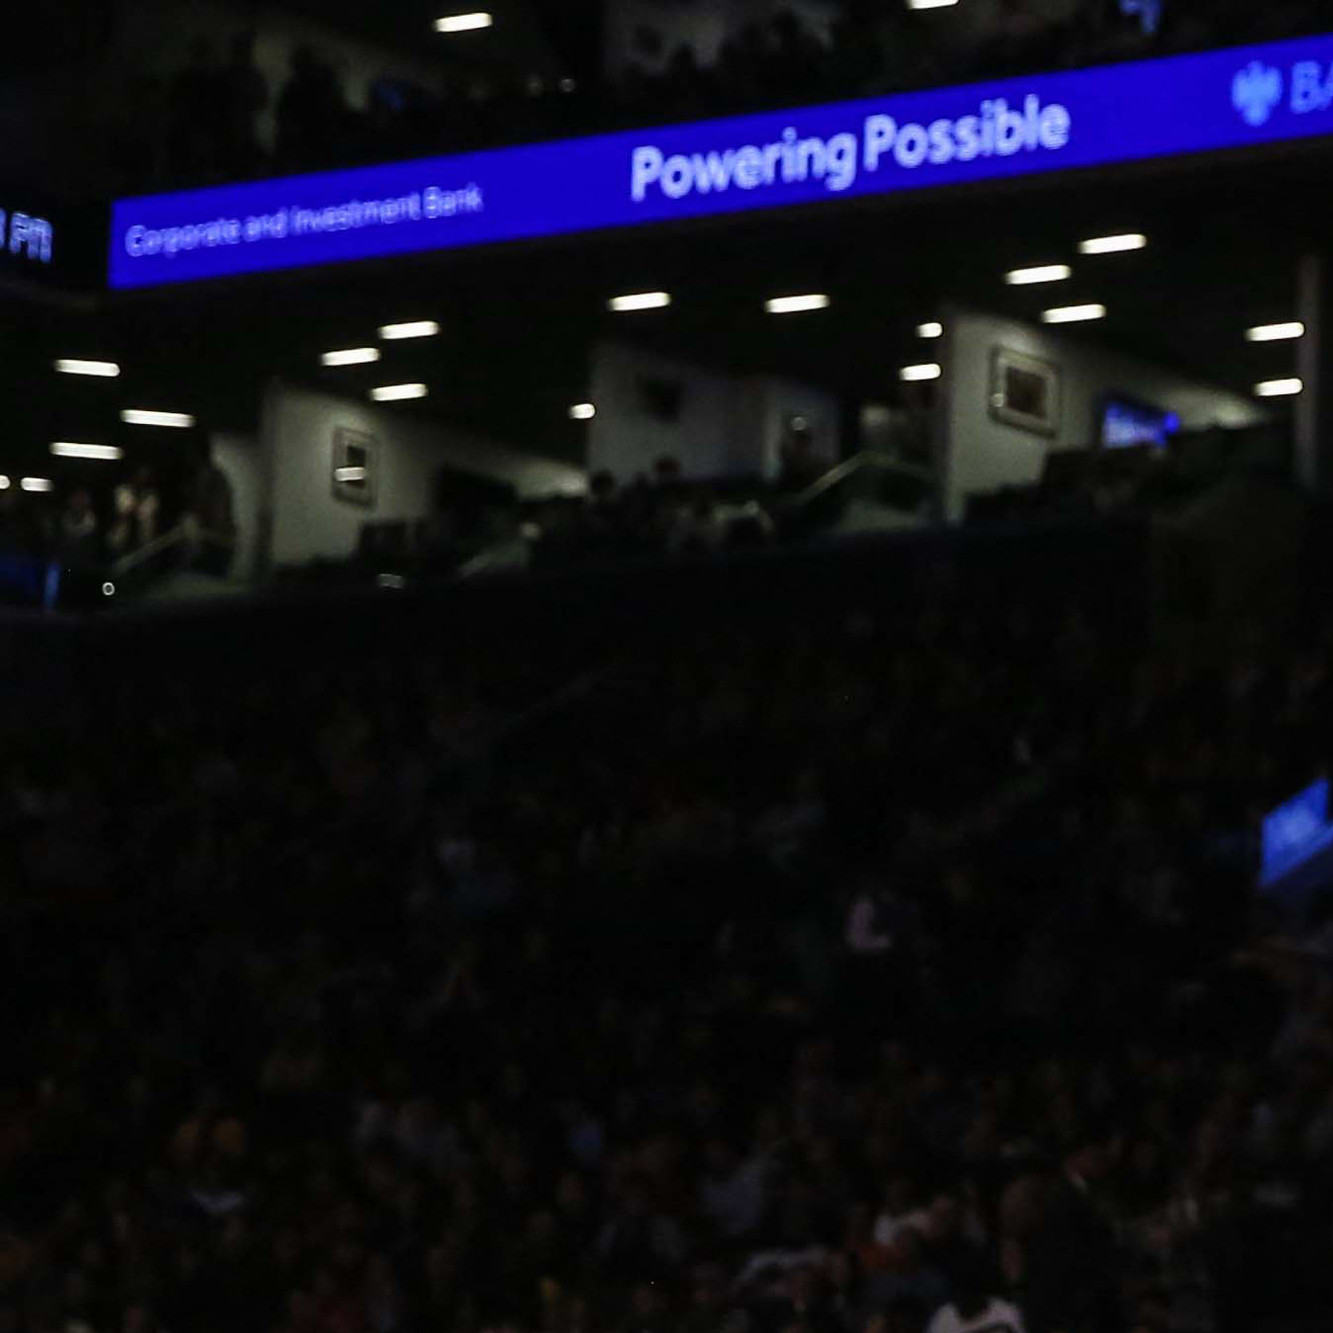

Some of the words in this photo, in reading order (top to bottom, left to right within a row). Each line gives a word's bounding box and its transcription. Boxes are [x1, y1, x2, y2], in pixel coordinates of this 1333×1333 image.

[631, 126, 857, 202] Powering
[863, 92, 1070, 172] Possible
[125, 217, 241, 258] Corporate
[243, 205, 288, 241] and
[423, 182, 483, 219] Bank
